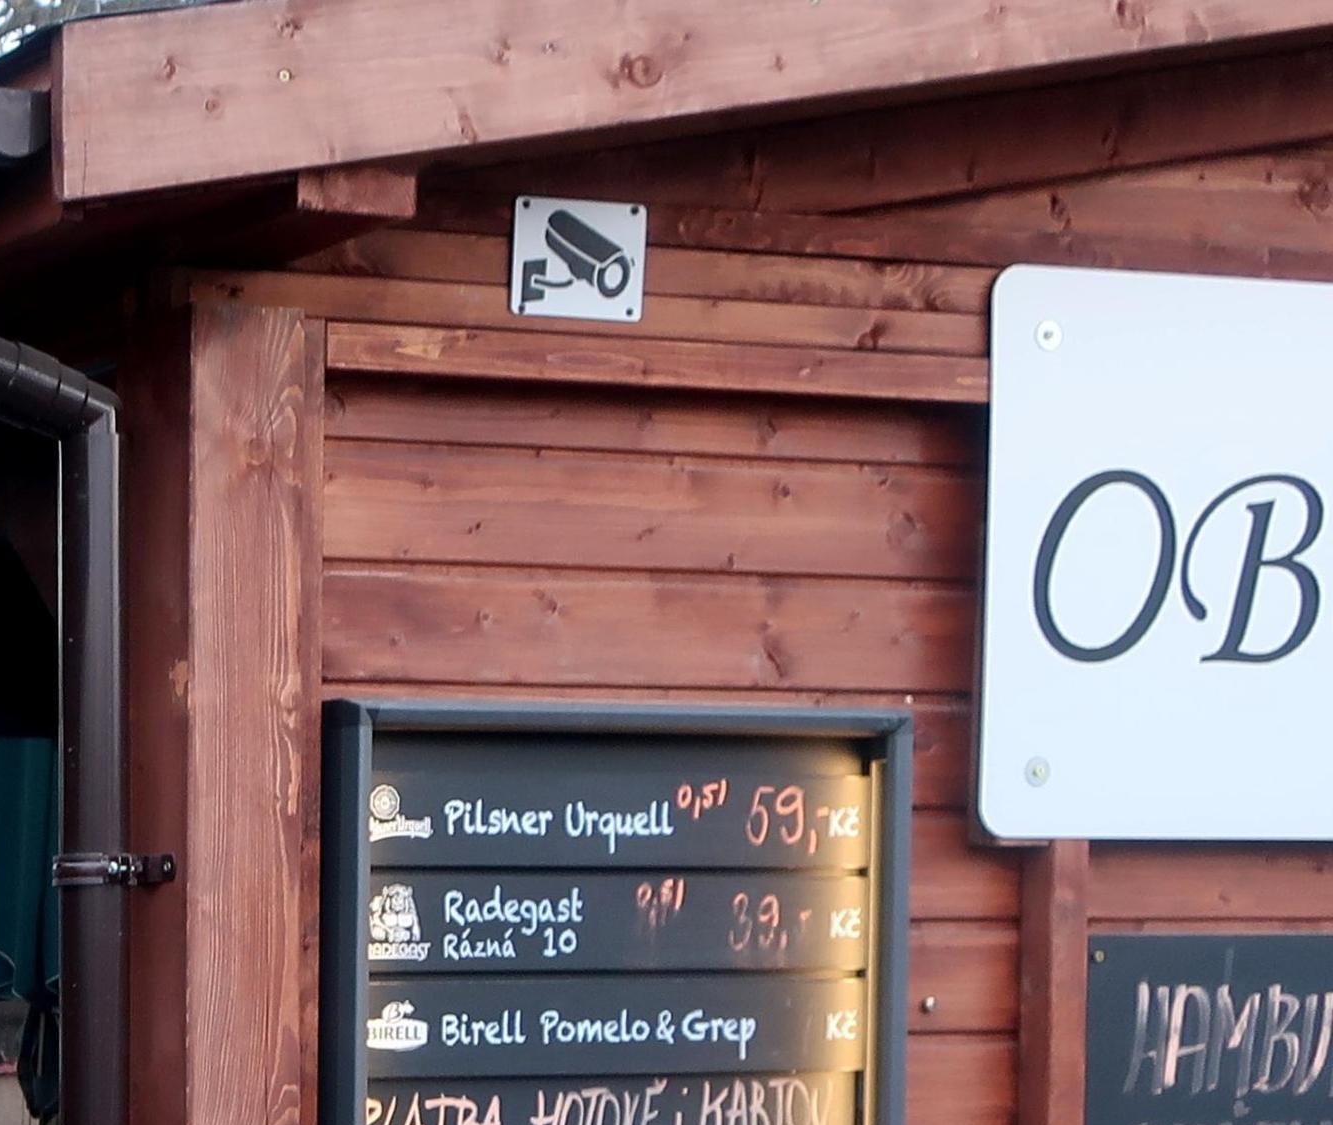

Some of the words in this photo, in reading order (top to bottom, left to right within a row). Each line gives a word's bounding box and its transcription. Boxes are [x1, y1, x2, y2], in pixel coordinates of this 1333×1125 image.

[444, 798, 553, 836] Pilsner
[565, 800, 675, 855] Urquell
[829, 808, 861, 838] Kč
[444, 884, 584, 935] Radegast
[829, 908, 862, 938] Kč
[443, 927, 517, 961] Rázná
[543, 927, 578, 957] 10
[441, 1009, 527, 1046] Birell
[540, 1009, 651, 1045] Pomelo
[655, 1009, 675, 1045] &
[682, 1008, 757, 1061] Grep
[825, 1008, 859, 1041] Kč
[1122, 980, 1333, 1097] HAMBU
